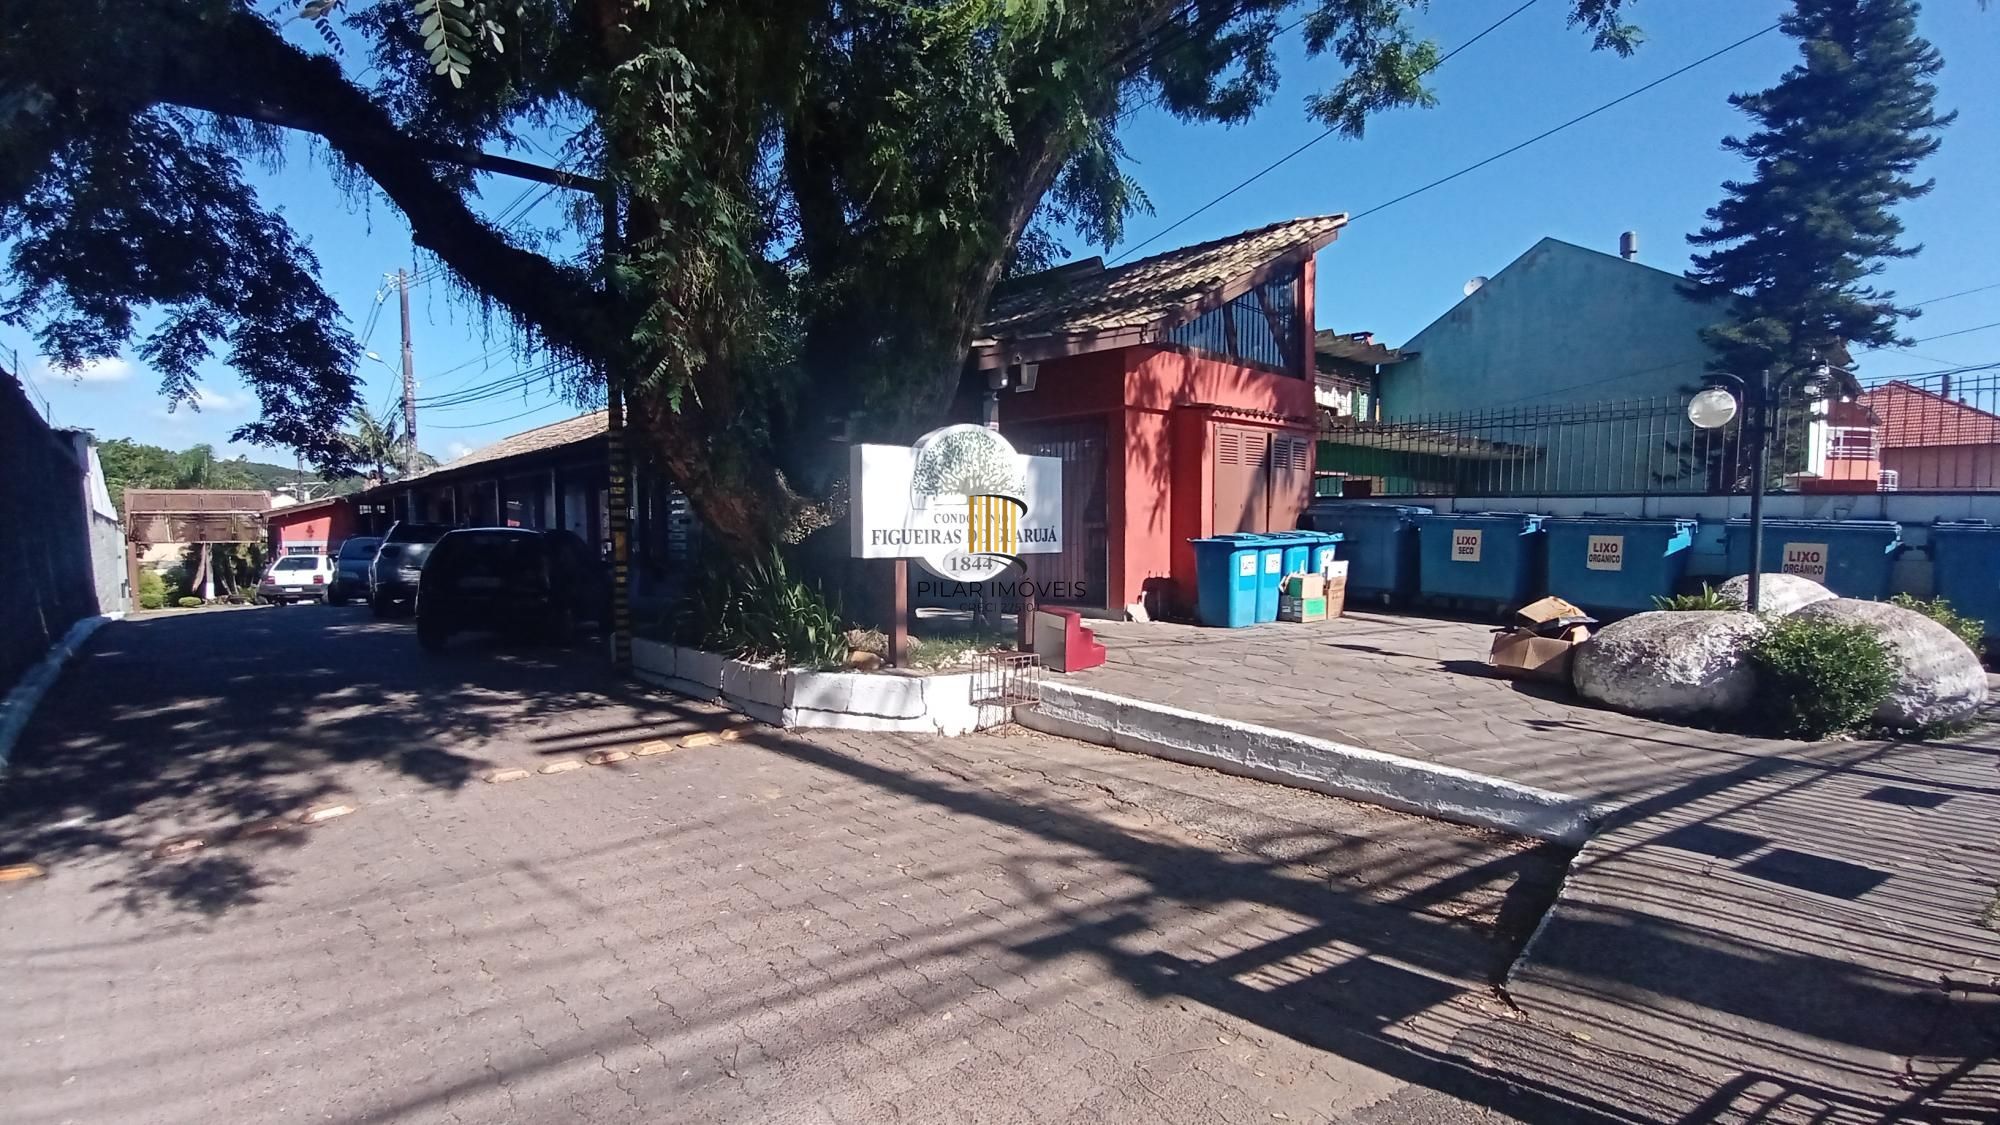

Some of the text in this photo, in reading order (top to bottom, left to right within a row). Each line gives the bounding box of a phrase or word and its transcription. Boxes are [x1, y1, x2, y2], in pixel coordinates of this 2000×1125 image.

[871, 528, 962, 546] FIGUEIRAS
[1456, 536, 1477, 546] LIXO
[1458, 546, 1474, 555] SECO
[1593, 543, 1619, 553] LIXO
[1788, 551, 1821, 563] LIXO
[950, 555, 993, 572] 1844
